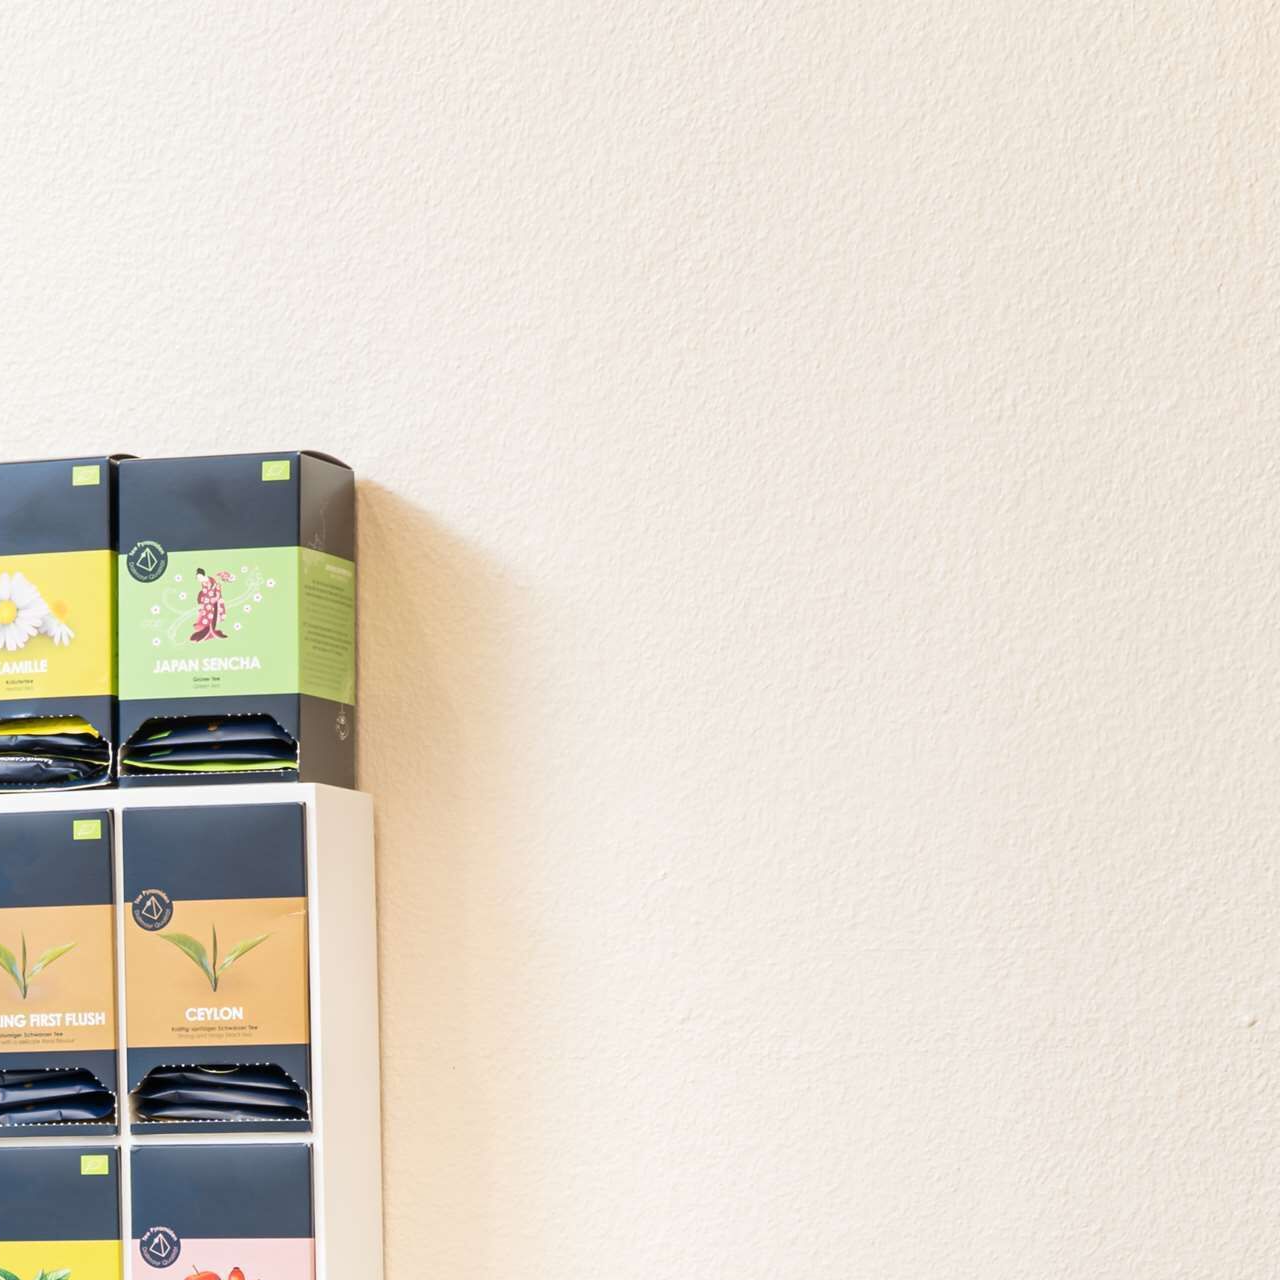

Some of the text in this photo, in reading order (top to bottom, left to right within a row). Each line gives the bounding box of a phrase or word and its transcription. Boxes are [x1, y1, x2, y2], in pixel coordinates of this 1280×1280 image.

[153, 655, 261, 674] JAPAN SENCHA
[29, 1013, 62, 1028] FIRST
[65, 1012, 106, 1026] FLUSH
[185, 1007, 243, 1021] CEYLON
